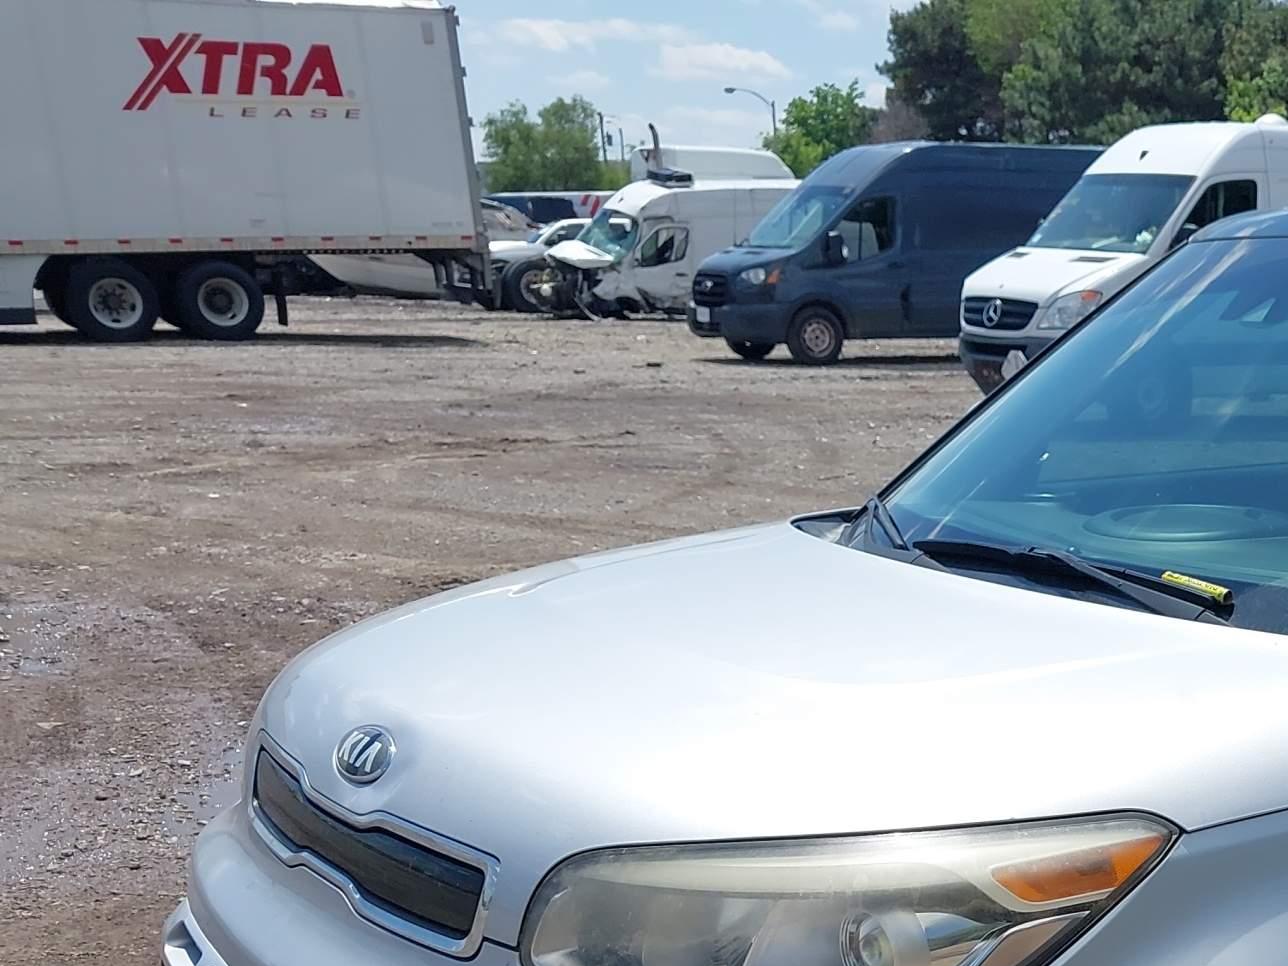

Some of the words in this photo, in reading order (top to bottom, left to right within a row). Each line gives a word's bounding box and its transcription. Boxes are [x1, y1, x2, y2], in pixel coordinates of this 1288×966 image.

[122, 33, 344, 110] XTRA
[208, 106, 361, 119] LEASE
[338, 731, 383, 773] KIA
